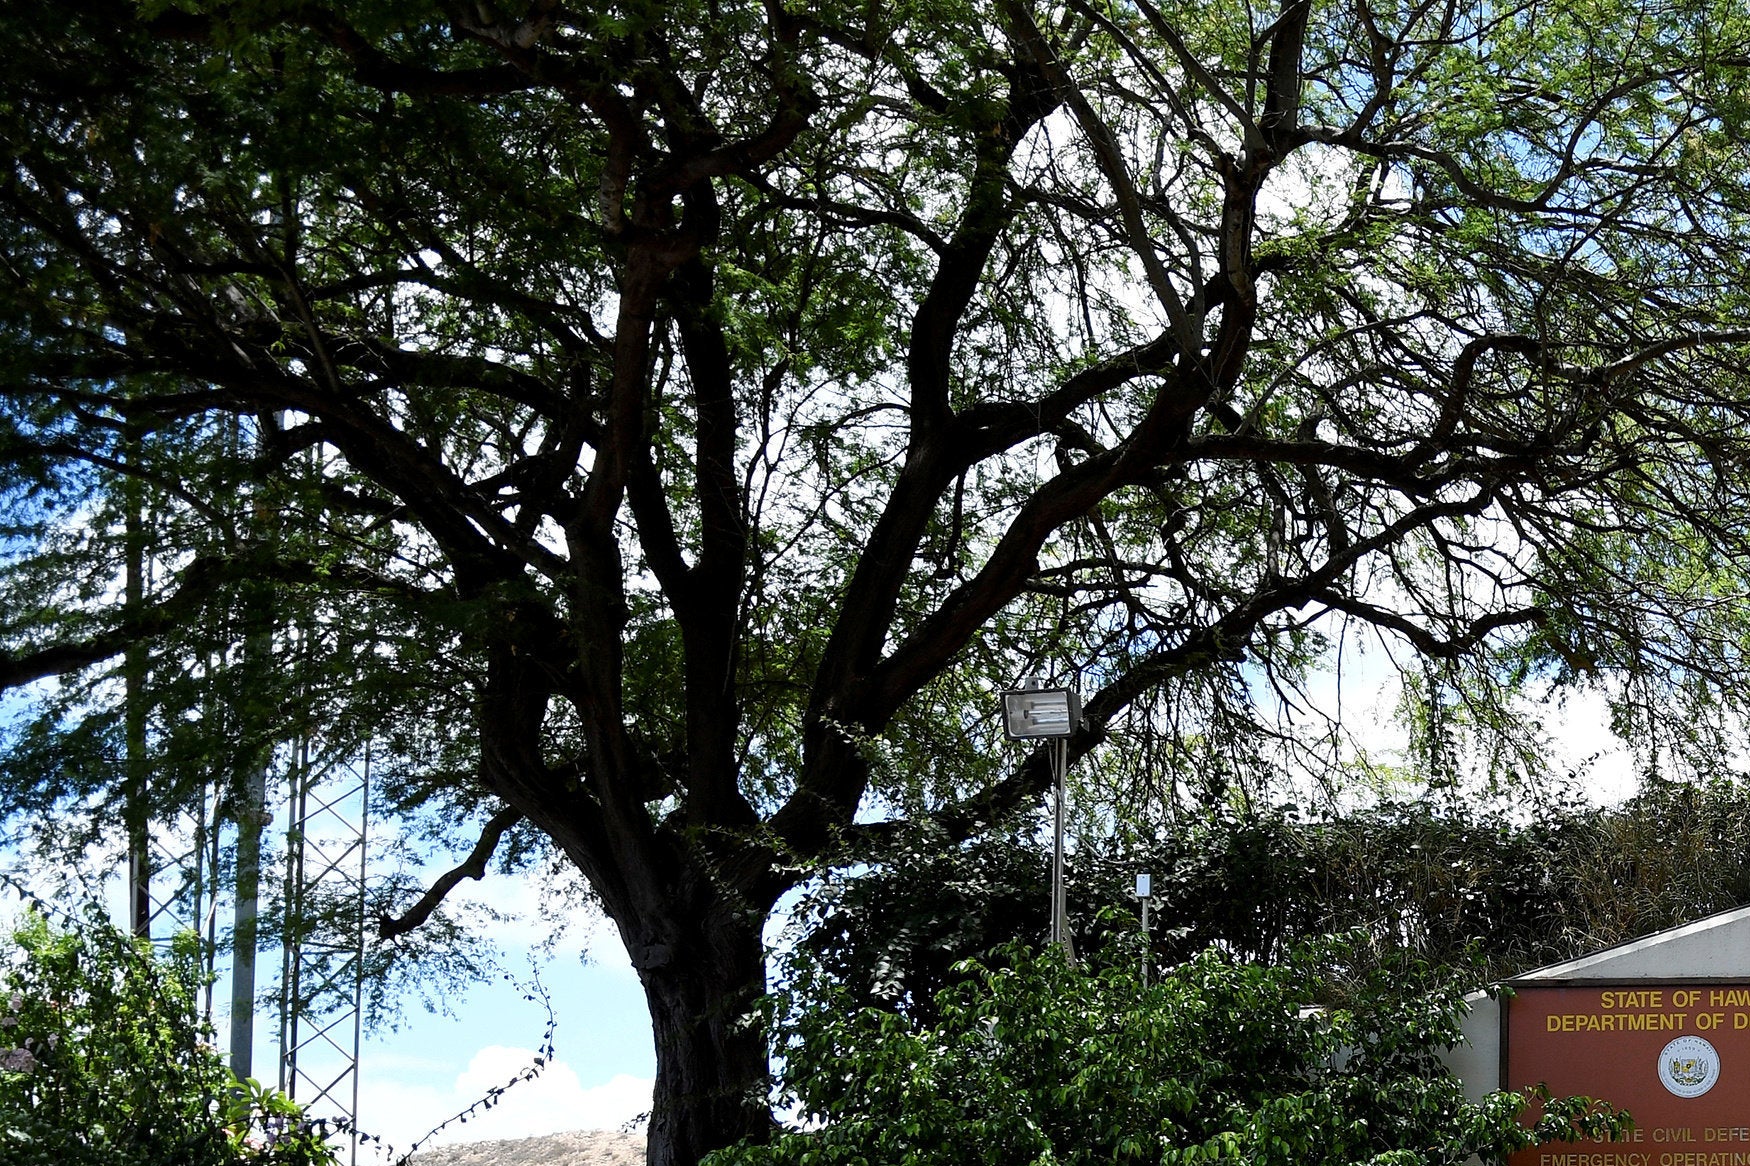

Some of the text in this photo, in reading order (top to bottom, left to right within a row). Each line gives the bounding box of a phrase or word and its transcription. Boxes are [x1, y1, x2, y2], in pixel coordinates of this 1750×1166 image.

[1601, 992, 1662, 1009] STATE
[1672, 991, 1700, 1008] OF
[1547, 1013, 1687, 1032] DEPARTMENT
[1696, 1013, 1724, 1030] OF
[1653, 1128, 1696, 1142] CIVIL
